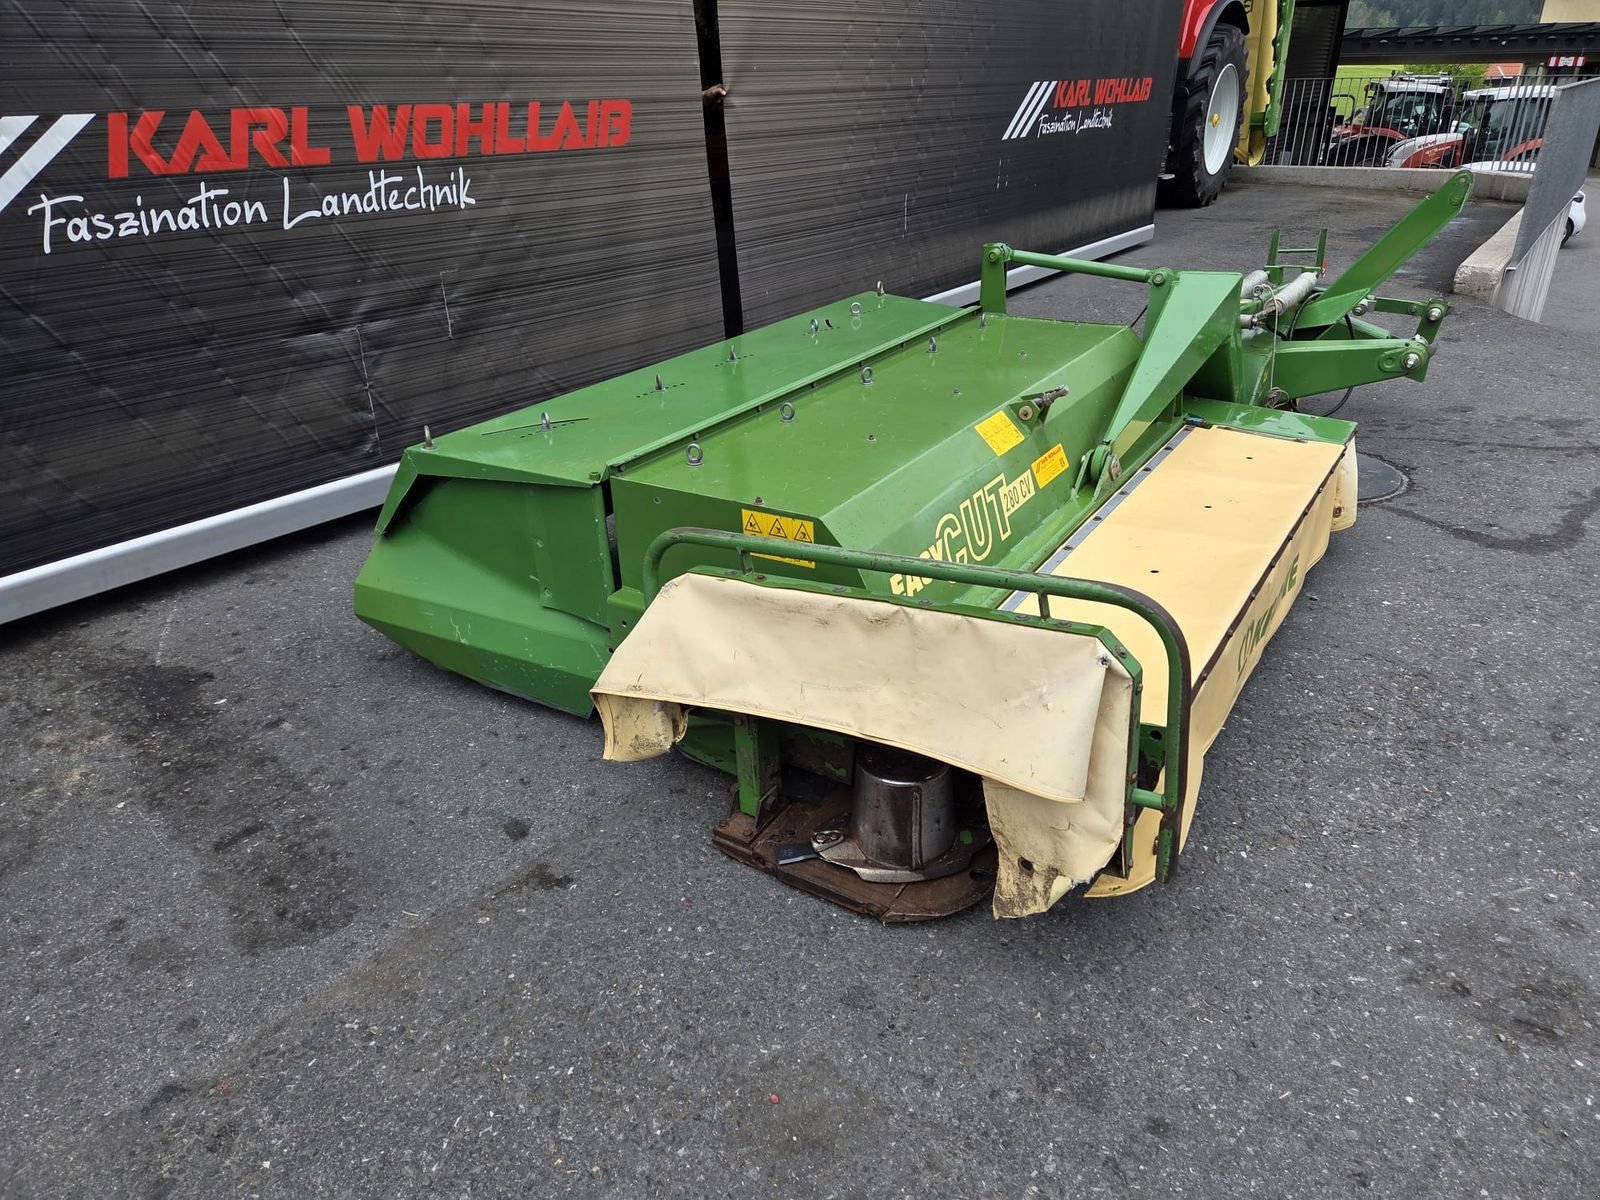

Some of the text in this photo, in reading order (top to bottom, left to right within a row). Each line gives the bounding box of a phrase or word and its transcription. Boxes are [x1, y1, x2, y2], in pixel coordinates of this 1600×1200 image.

[1053, 77, 1152, 108] KARL WOHLLAIB
[107, 99, 633, 178] KARL WOHLLAIB
[27, 165, 476, 254] Faszination Landtechnik
[1003, 474, 1031, 513] 280 CV
